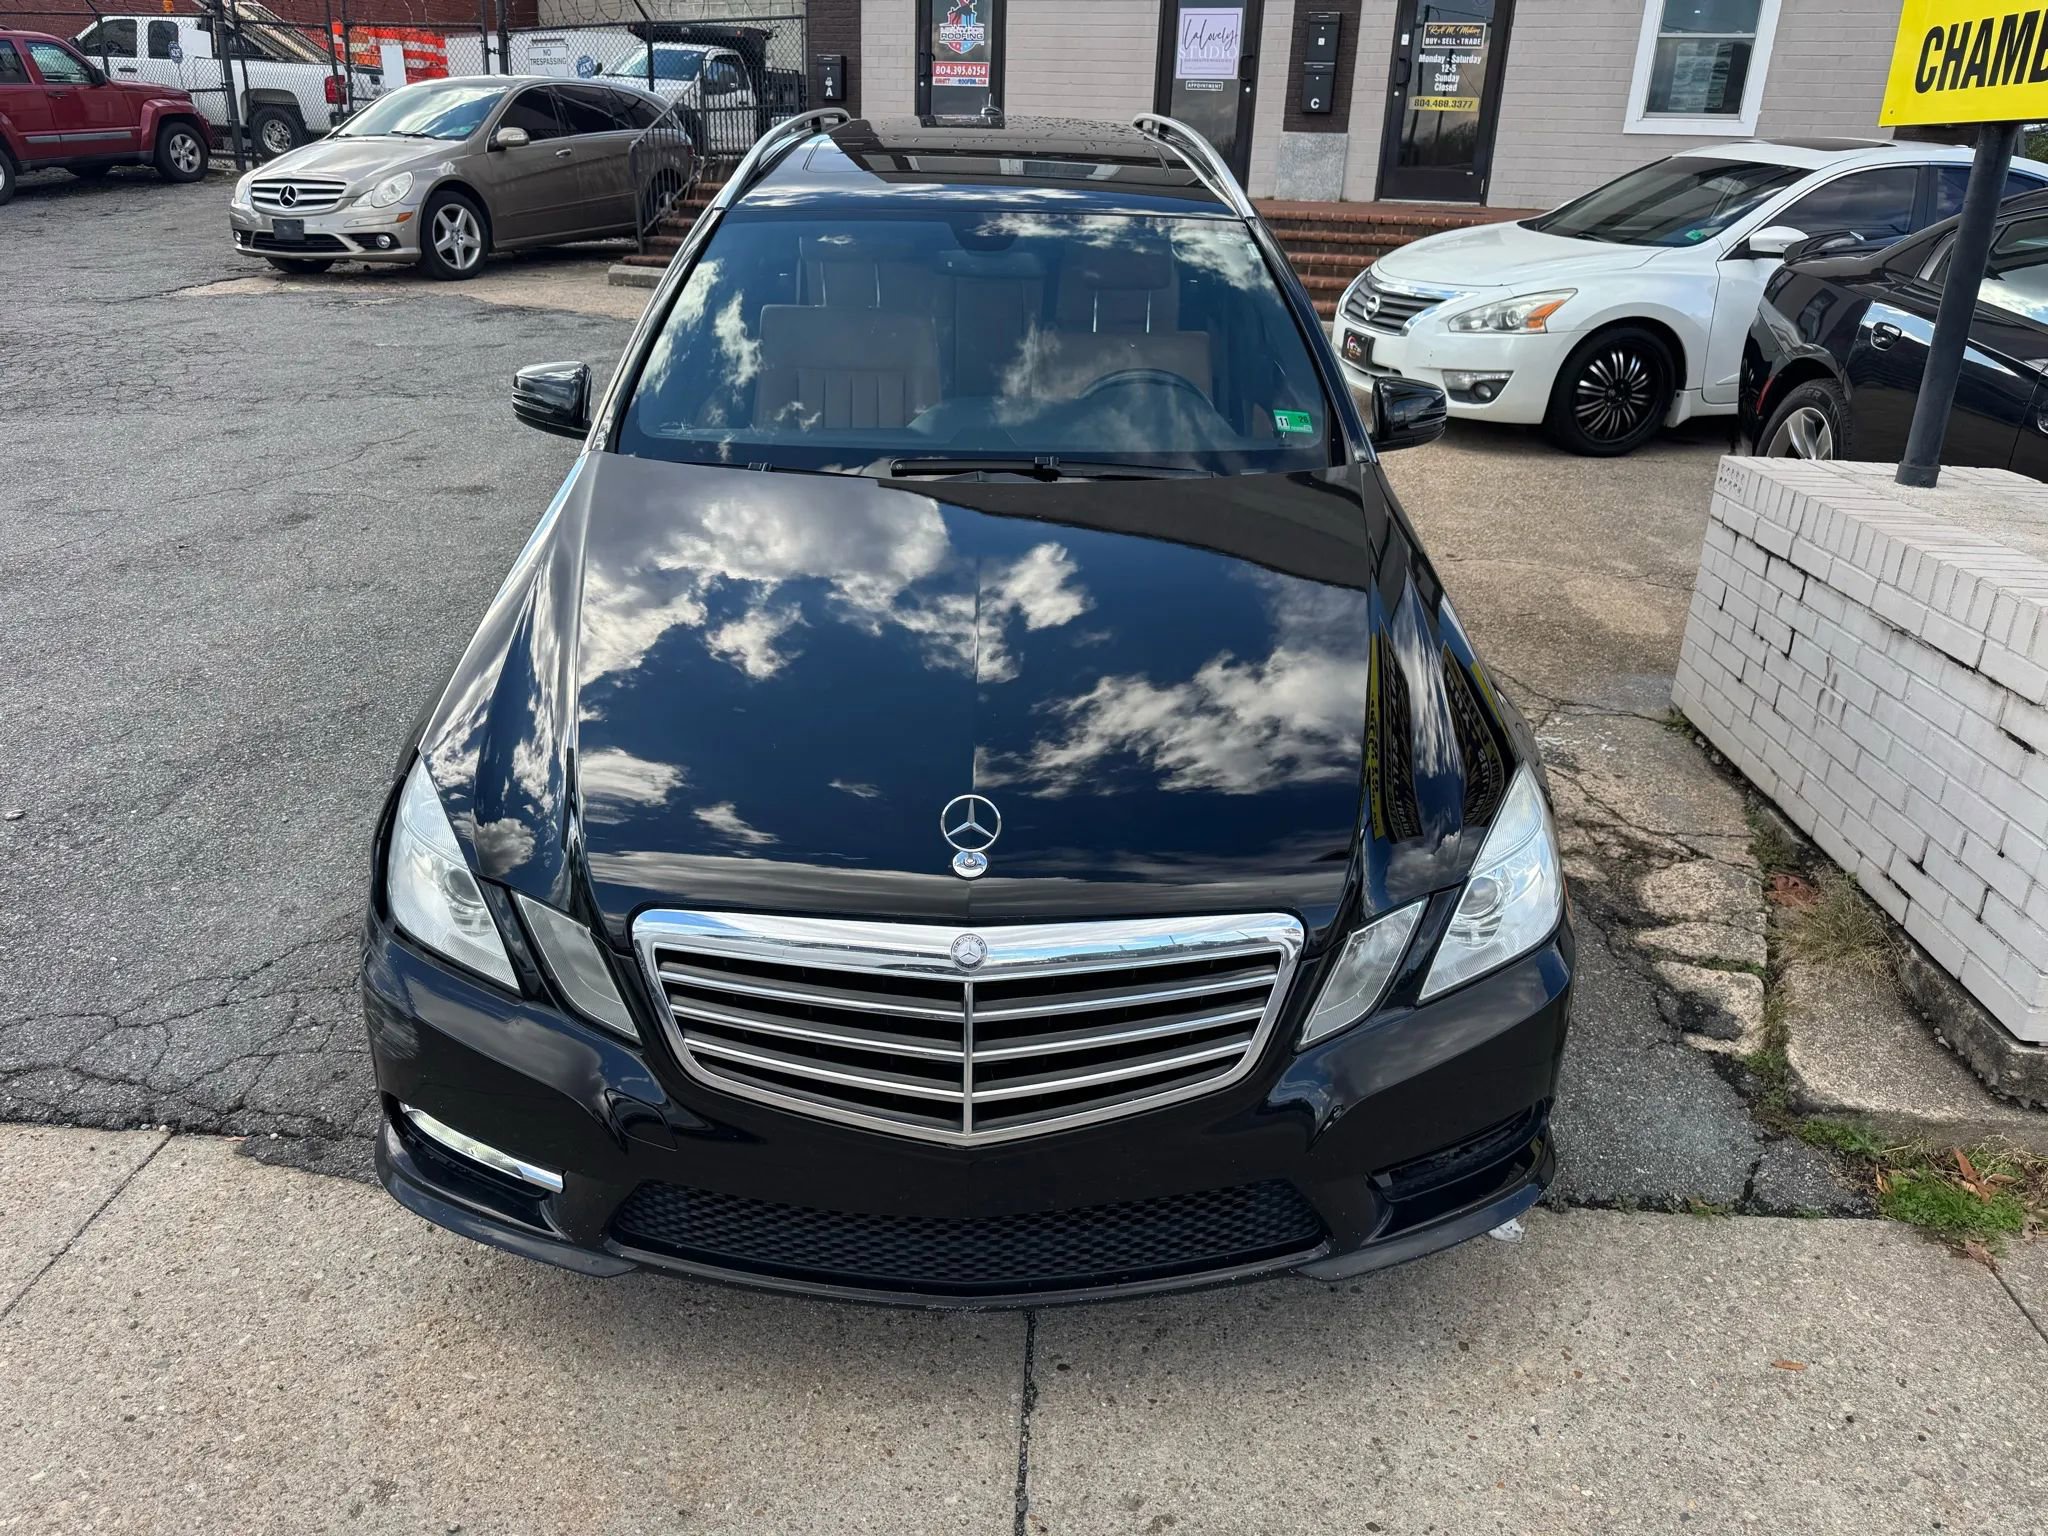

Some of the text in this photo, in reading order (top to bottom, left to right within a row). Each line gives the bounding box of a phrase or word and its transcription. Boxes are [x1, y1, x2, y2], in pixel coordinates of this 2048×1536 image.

[941, 32, 984, 40] ROOFING
[1425, 37, 1482, 46] BUY SELL TRADE
[1178, 45, 1238, 59] STUDIO
[1418, 54, 1446, 64] Monday
[1451, 54, 1482, 65] Saturday
[1441, 64, 1457, 73] 12-5
[1434, 73, 1460, 83] Sunday
[825, 87, 833, 97] A
[1434, 82, 1458, 92] Closed
[1310, 97, 1320, 109] C
[1278, 417, 1289, 427] 11
